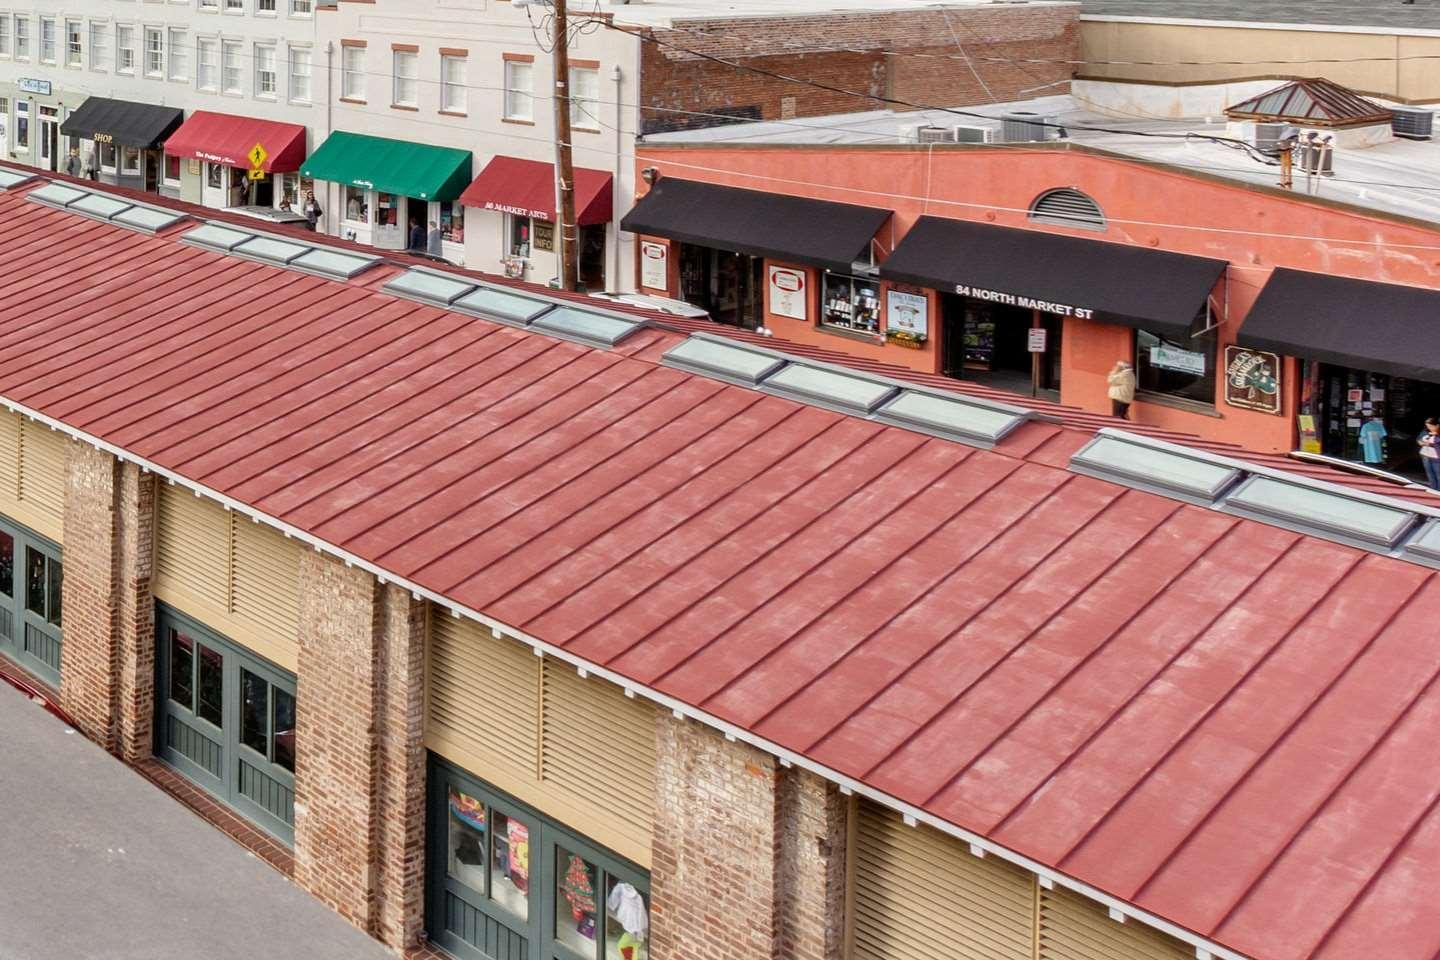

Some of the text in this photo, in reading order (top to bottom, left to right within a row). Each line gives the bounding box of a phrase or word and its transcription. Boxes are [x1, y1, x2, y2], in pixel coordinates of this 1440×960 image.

[494, 203, 528, 216] MARKET
[528, 210, 548, 220] ARTS
[955, 285, 1093, 320] 84 NORTH MARKET ST
